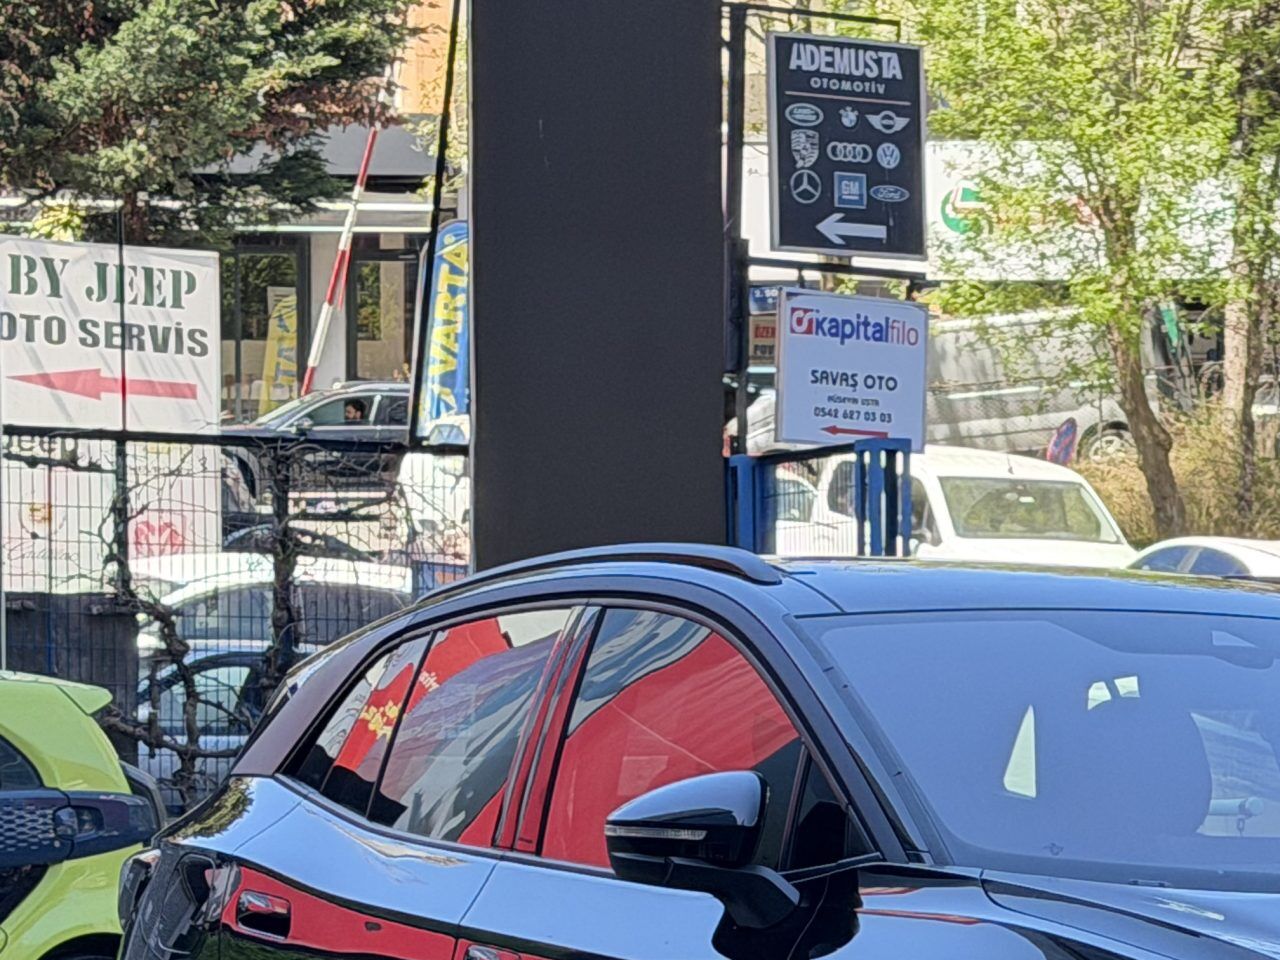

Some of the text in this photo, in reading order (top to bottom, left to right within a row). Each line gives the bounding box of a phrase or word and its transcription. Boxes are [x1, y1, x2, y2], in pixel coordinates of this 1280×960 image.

[789, 42, 903, 80] ADEMUSTA
[810, 76, 886, 95] OTOMOTİV
[7, 253, 197, 309] BY JEEP
[428, 243, 469, 377] VARTA
[814, 309, 919, 346] kapitalfilo
[0, 312, 209, 357] OTO SERVİS
[810, 369, 898, 392] SAVAŞ OTO
[814, 407, 892, 423] 0542 627 03 03
